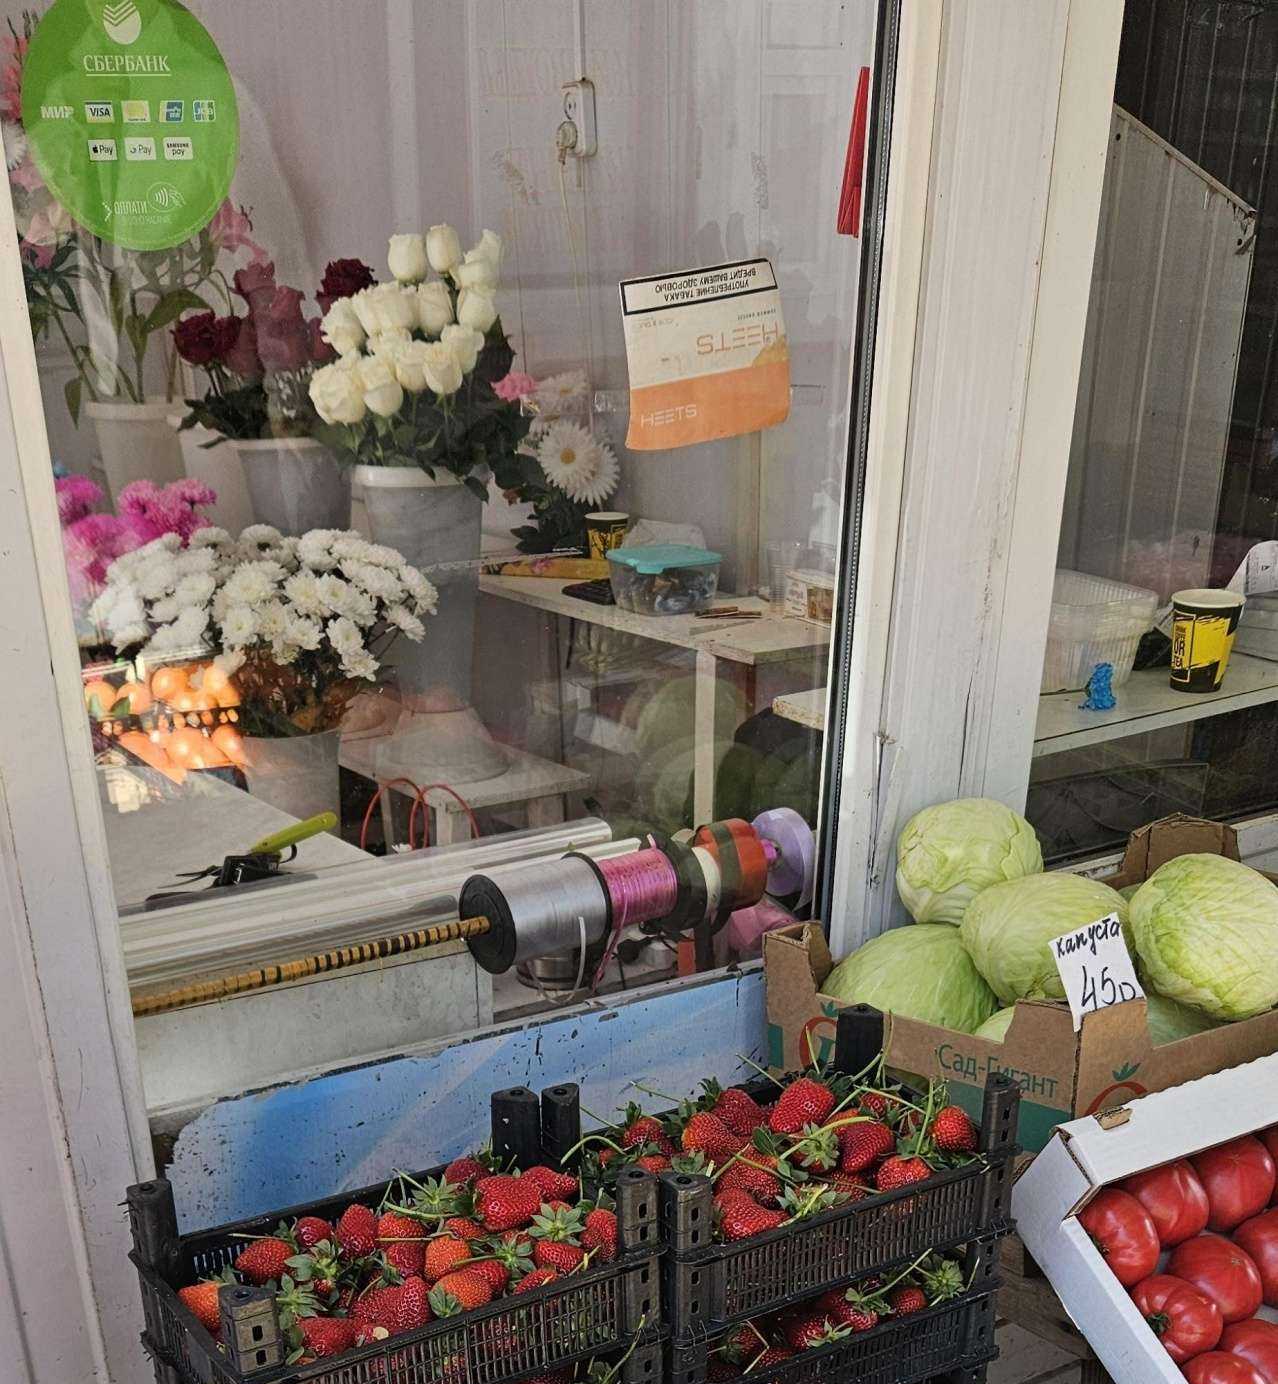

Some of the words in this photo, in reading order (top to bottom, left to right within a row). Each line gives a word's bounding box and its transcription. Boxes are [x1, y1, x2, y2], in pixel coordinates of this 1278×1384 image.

[83, 54, 171, 72] СБЕРБАНК
[40, 105, 75, 119] МИР
[89, 107, 111, 118] VISA
[99, 145, 113, 156] Pay
[114, 200, 148, 215] ОПЛАТИ
[699, 272, 728, 285] ВАШЕМУ
[730, 267, 757, 281] ВРЕДИТ
[655, 277, 698, 294] ЗДОРОВЬЮ
[697, 280, 749, 297] УПОТРЕБЛЕНИЕ
[664, 291, 694, 302] ТАБАКА
[696, 320, 779, 356] HEETS
[640, 404, 698, 428] HEETS
